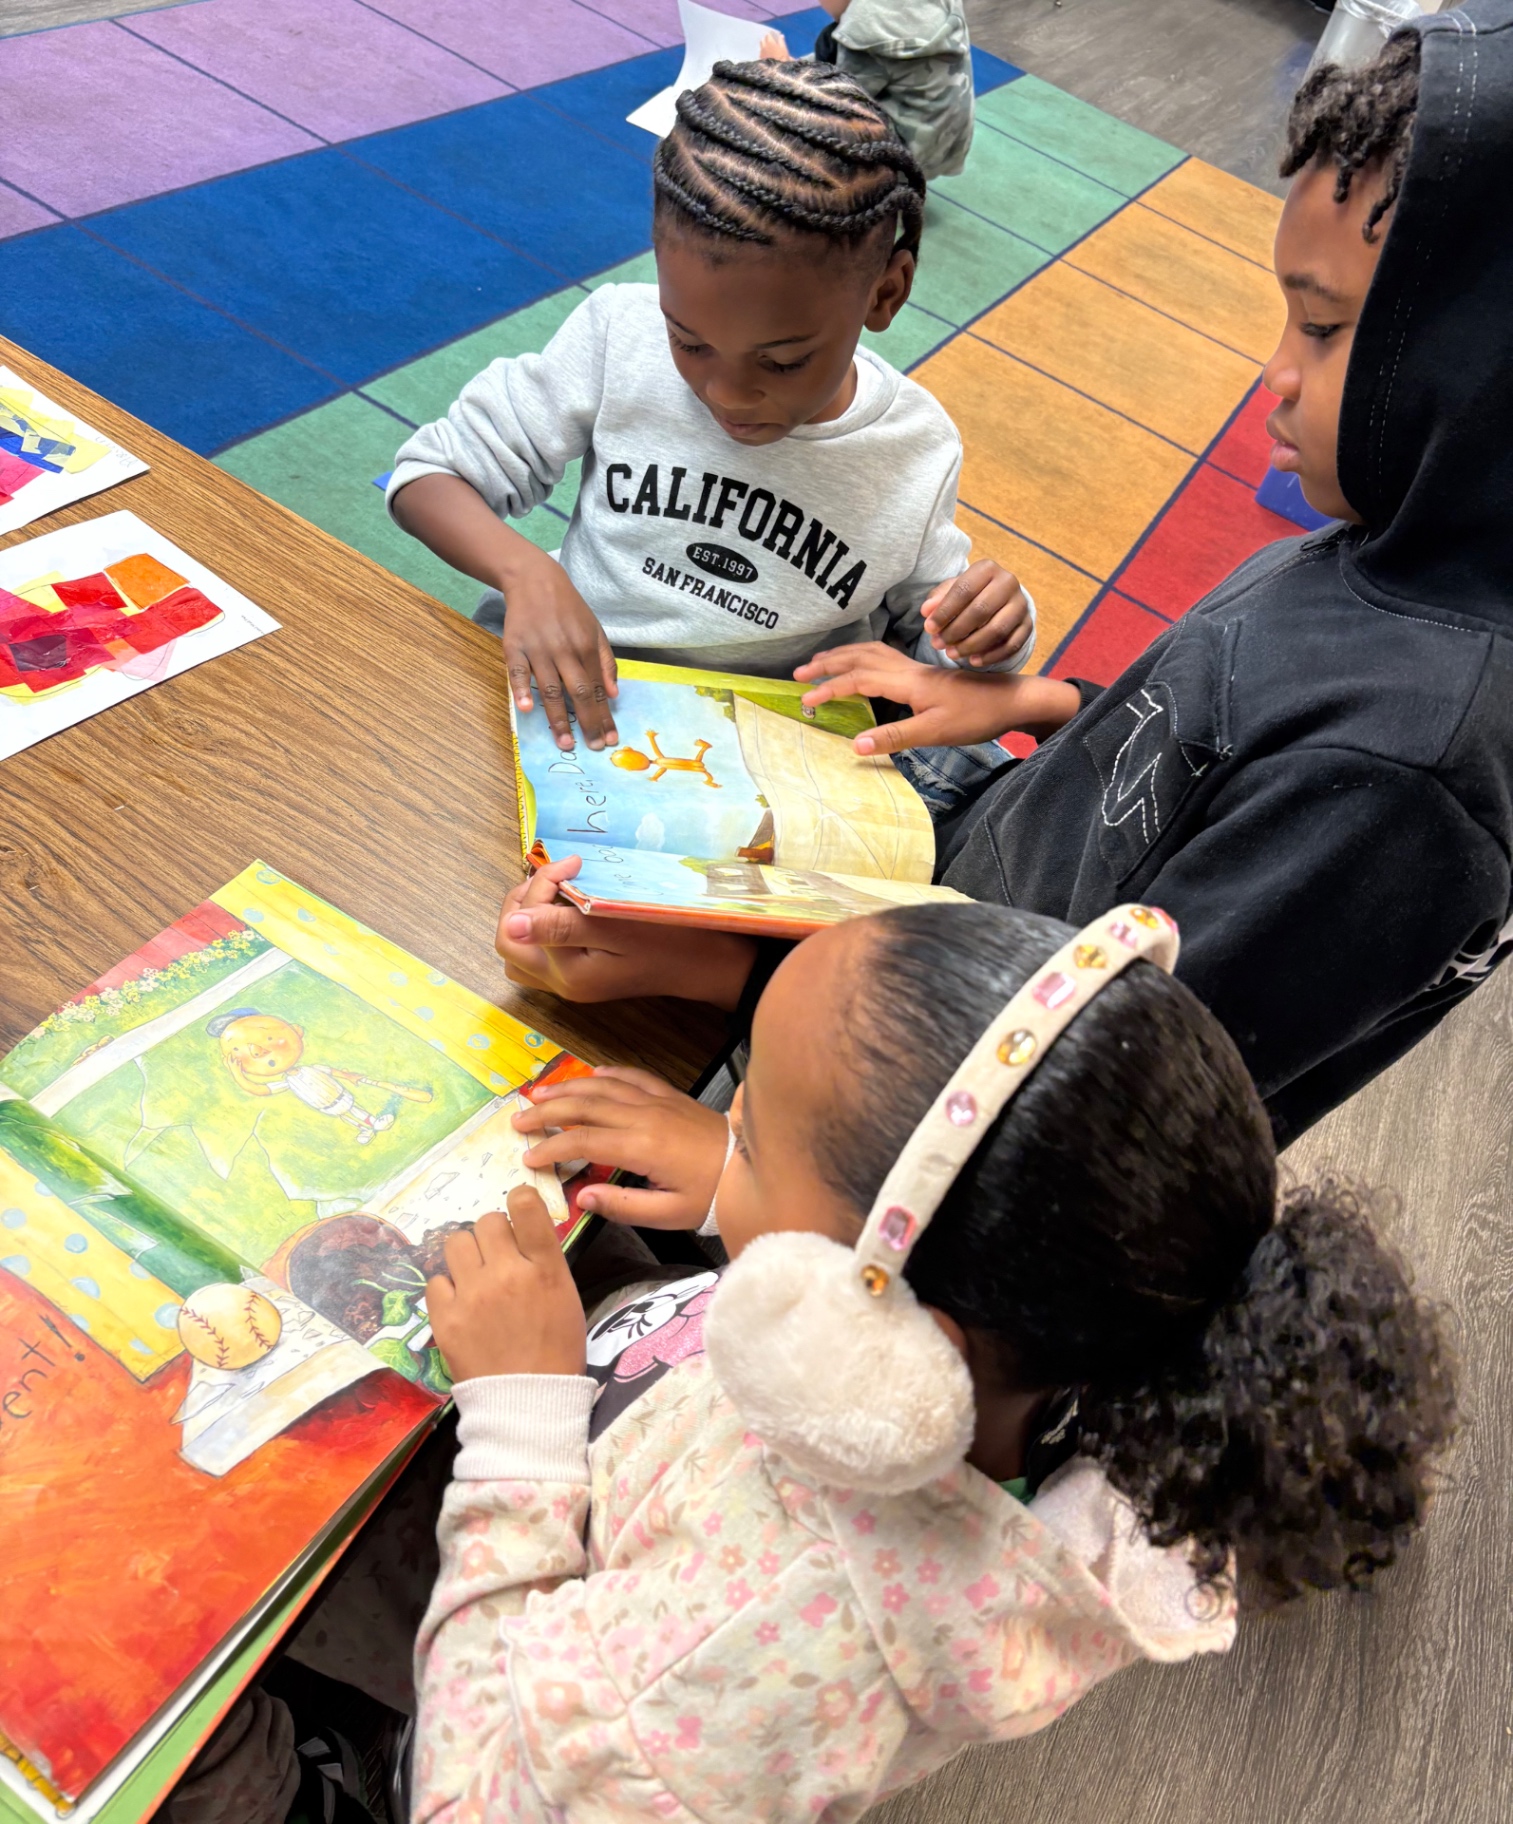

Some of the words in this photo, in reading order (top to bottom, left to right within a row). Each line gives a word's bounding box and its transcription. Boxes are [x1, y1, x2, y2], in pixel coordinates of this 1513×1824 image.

[606, 463, 868, 610] CALIFORNIA
[641, 557, 684, 588] SAN
[680, 577, 779, 630] FRANCISCO
